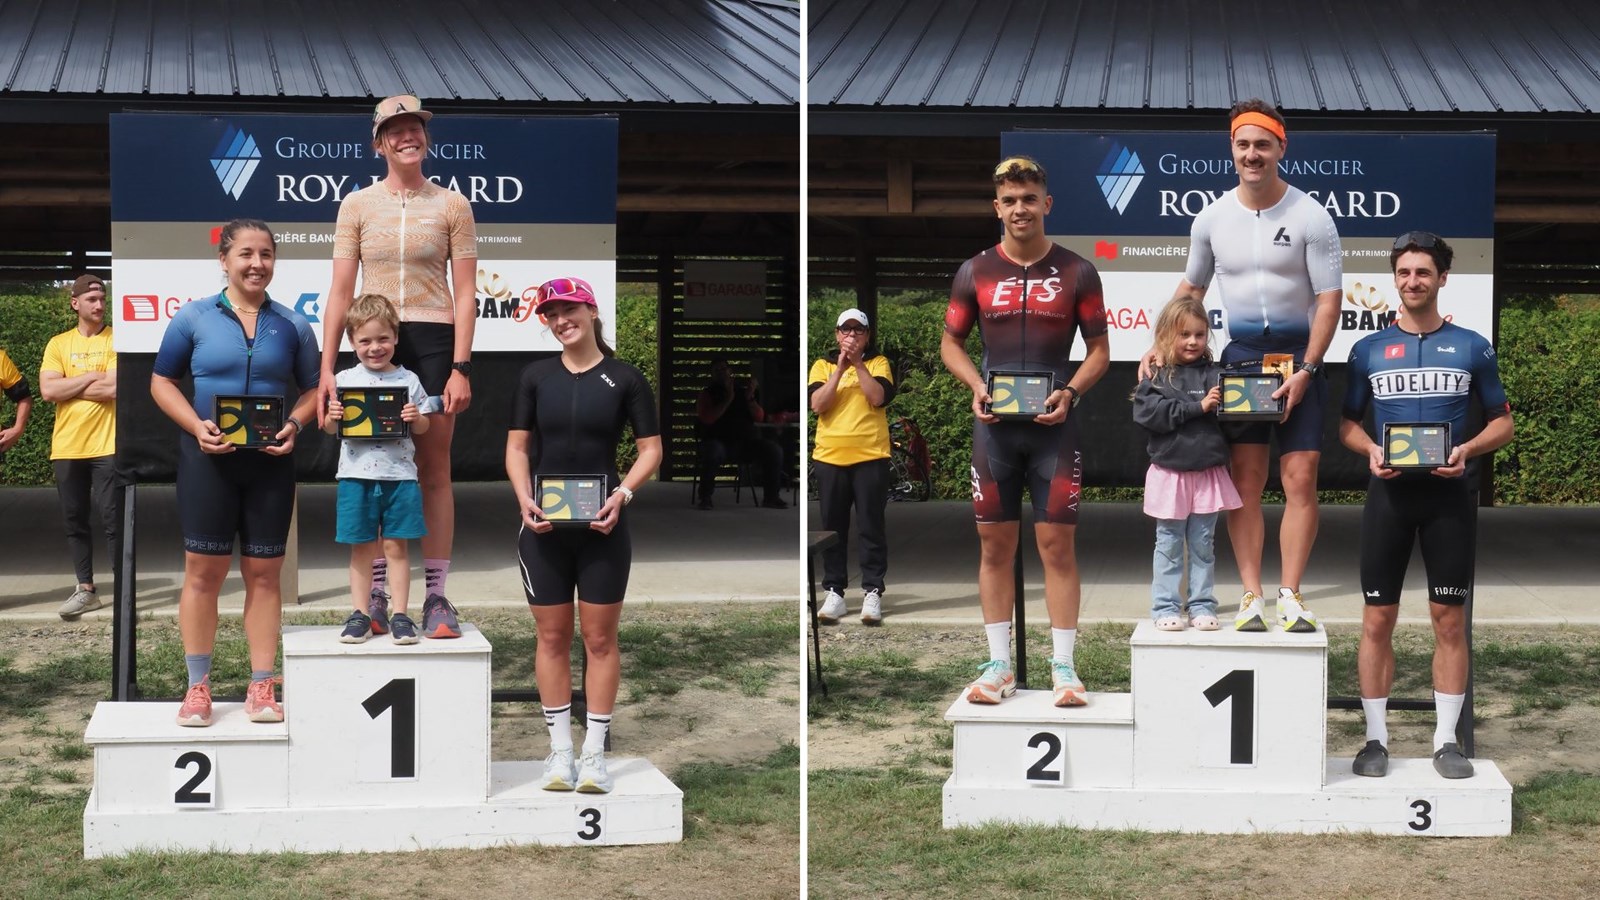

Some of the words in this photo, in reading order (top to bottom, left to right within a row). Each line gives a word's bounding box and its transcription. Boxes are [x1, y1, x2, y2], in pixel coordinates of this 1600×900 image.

[1159, 153, 1238, 175] GROUP
[274, 231, 306, 243] CIÈRE
[1122, 244, 1188, 257] FINANCIÈRE
[1352, 250, 1392, 258] PATRIMOI
[708, 282, 763, 297] GARAGA
[992, 277, 1061, 307] ÉTS
[1106, 308, 1150, 330] AGA
[1341, 310, 1397, 331] BAM
[1376, 373, 1464, 395] FIDELITY
[1067, 450, 1081, 512] AXIUM
[361, 678, 416, 778] 1
[1203, 669, 1254, 764] 1
[1026, 732, 1061, 780] 2
[174, 751, 212, 803] 2
[577, 808, 602, 840] 3
[1408, 800, 1432, 831] 3
